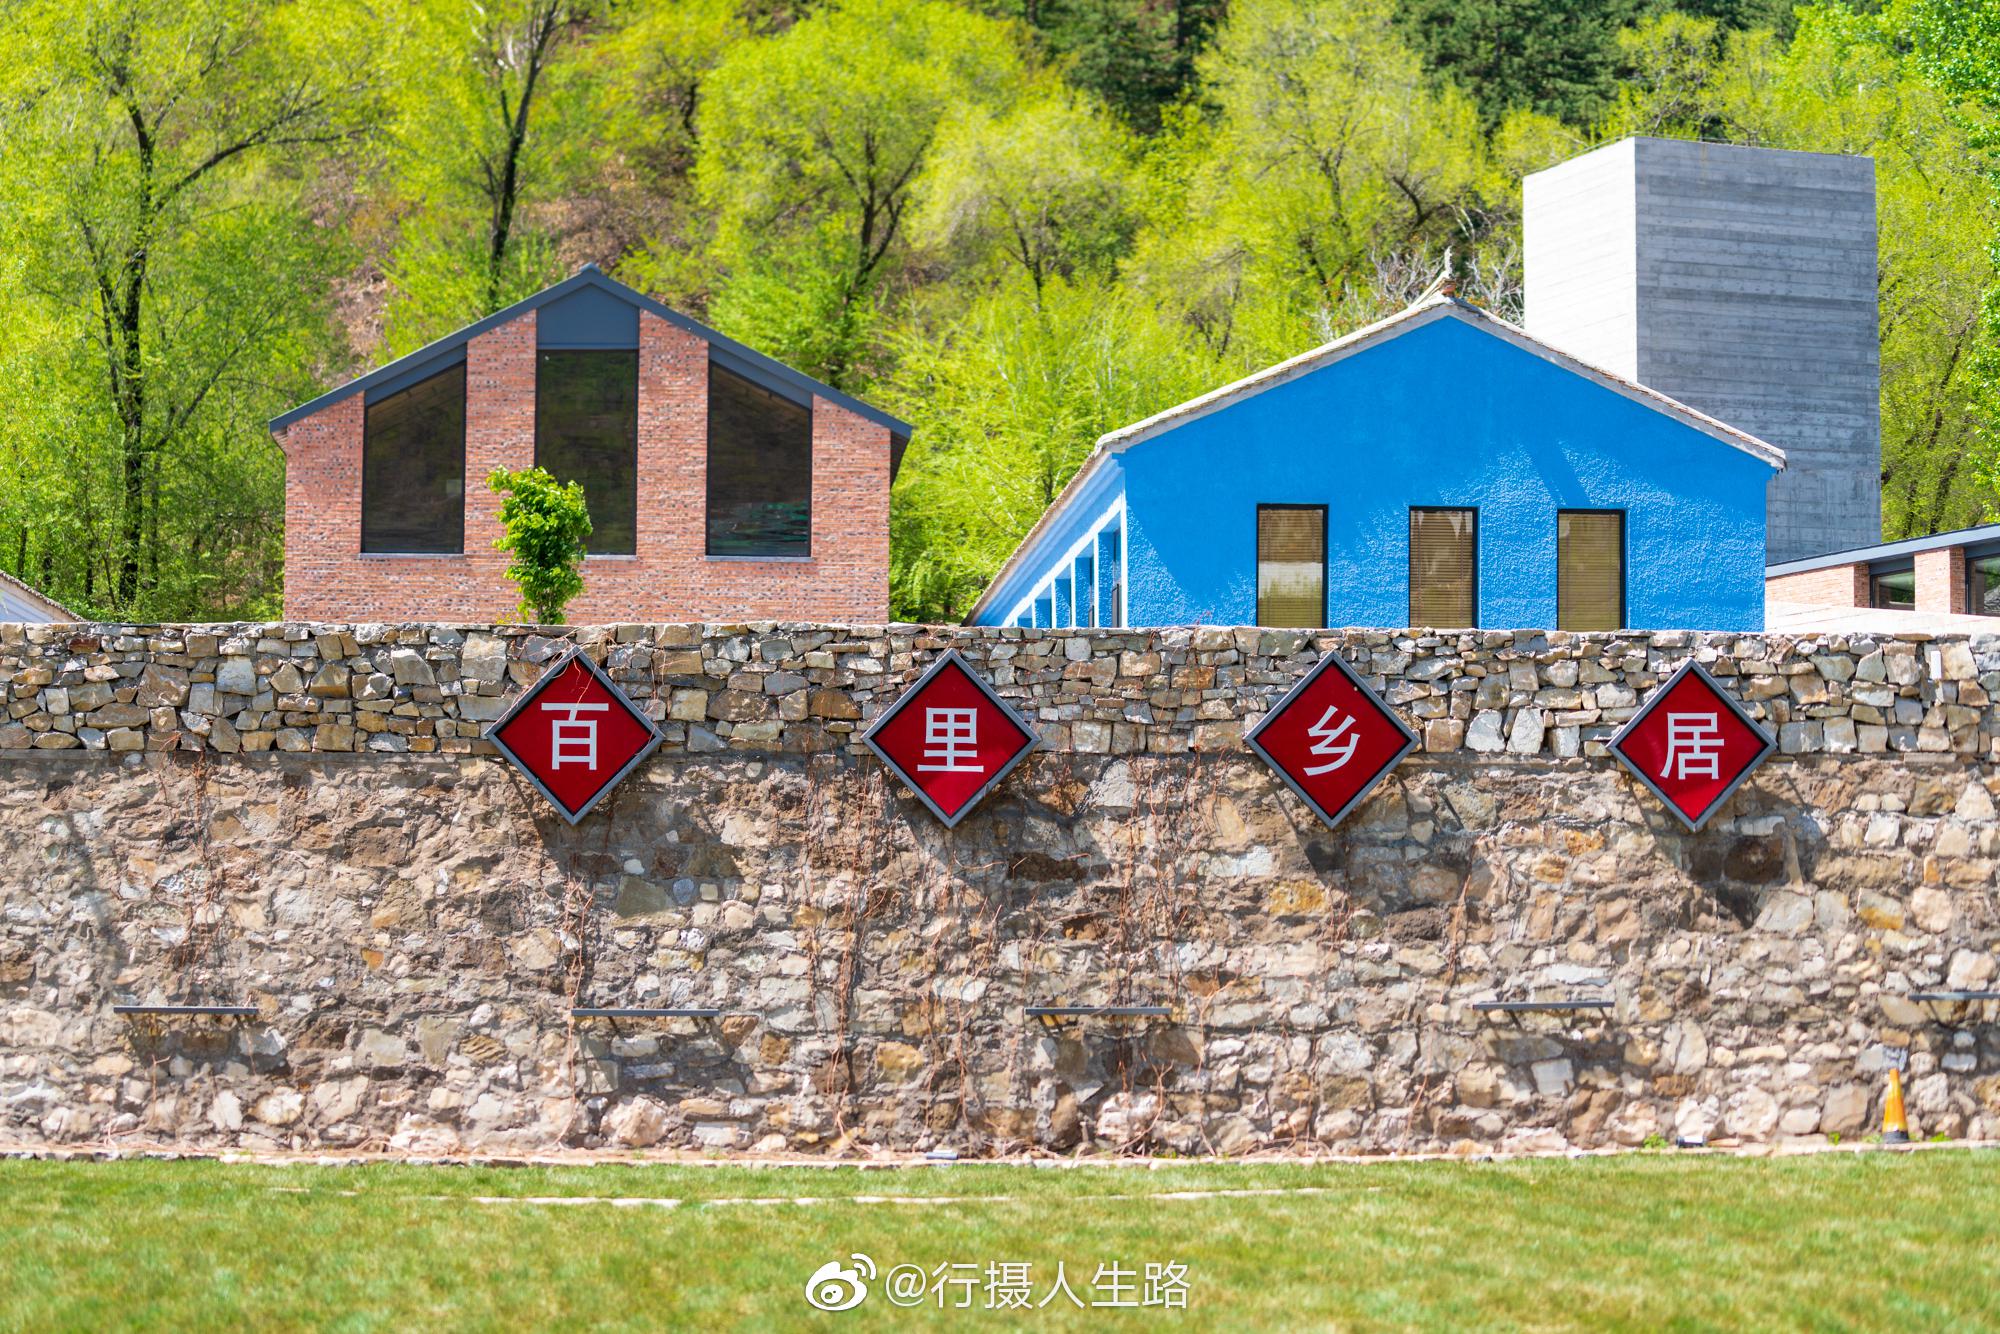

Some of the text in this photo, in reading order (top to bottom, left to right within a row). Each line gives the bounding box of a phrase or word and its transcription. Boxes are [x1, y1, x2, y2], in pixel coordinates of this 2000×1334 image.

[541, 702, 609, 770] 百
[917, 707, 984, 773] 里
[1303, 705, 1361, 776] 乡
[1659, 712, 1725, 780] 居
